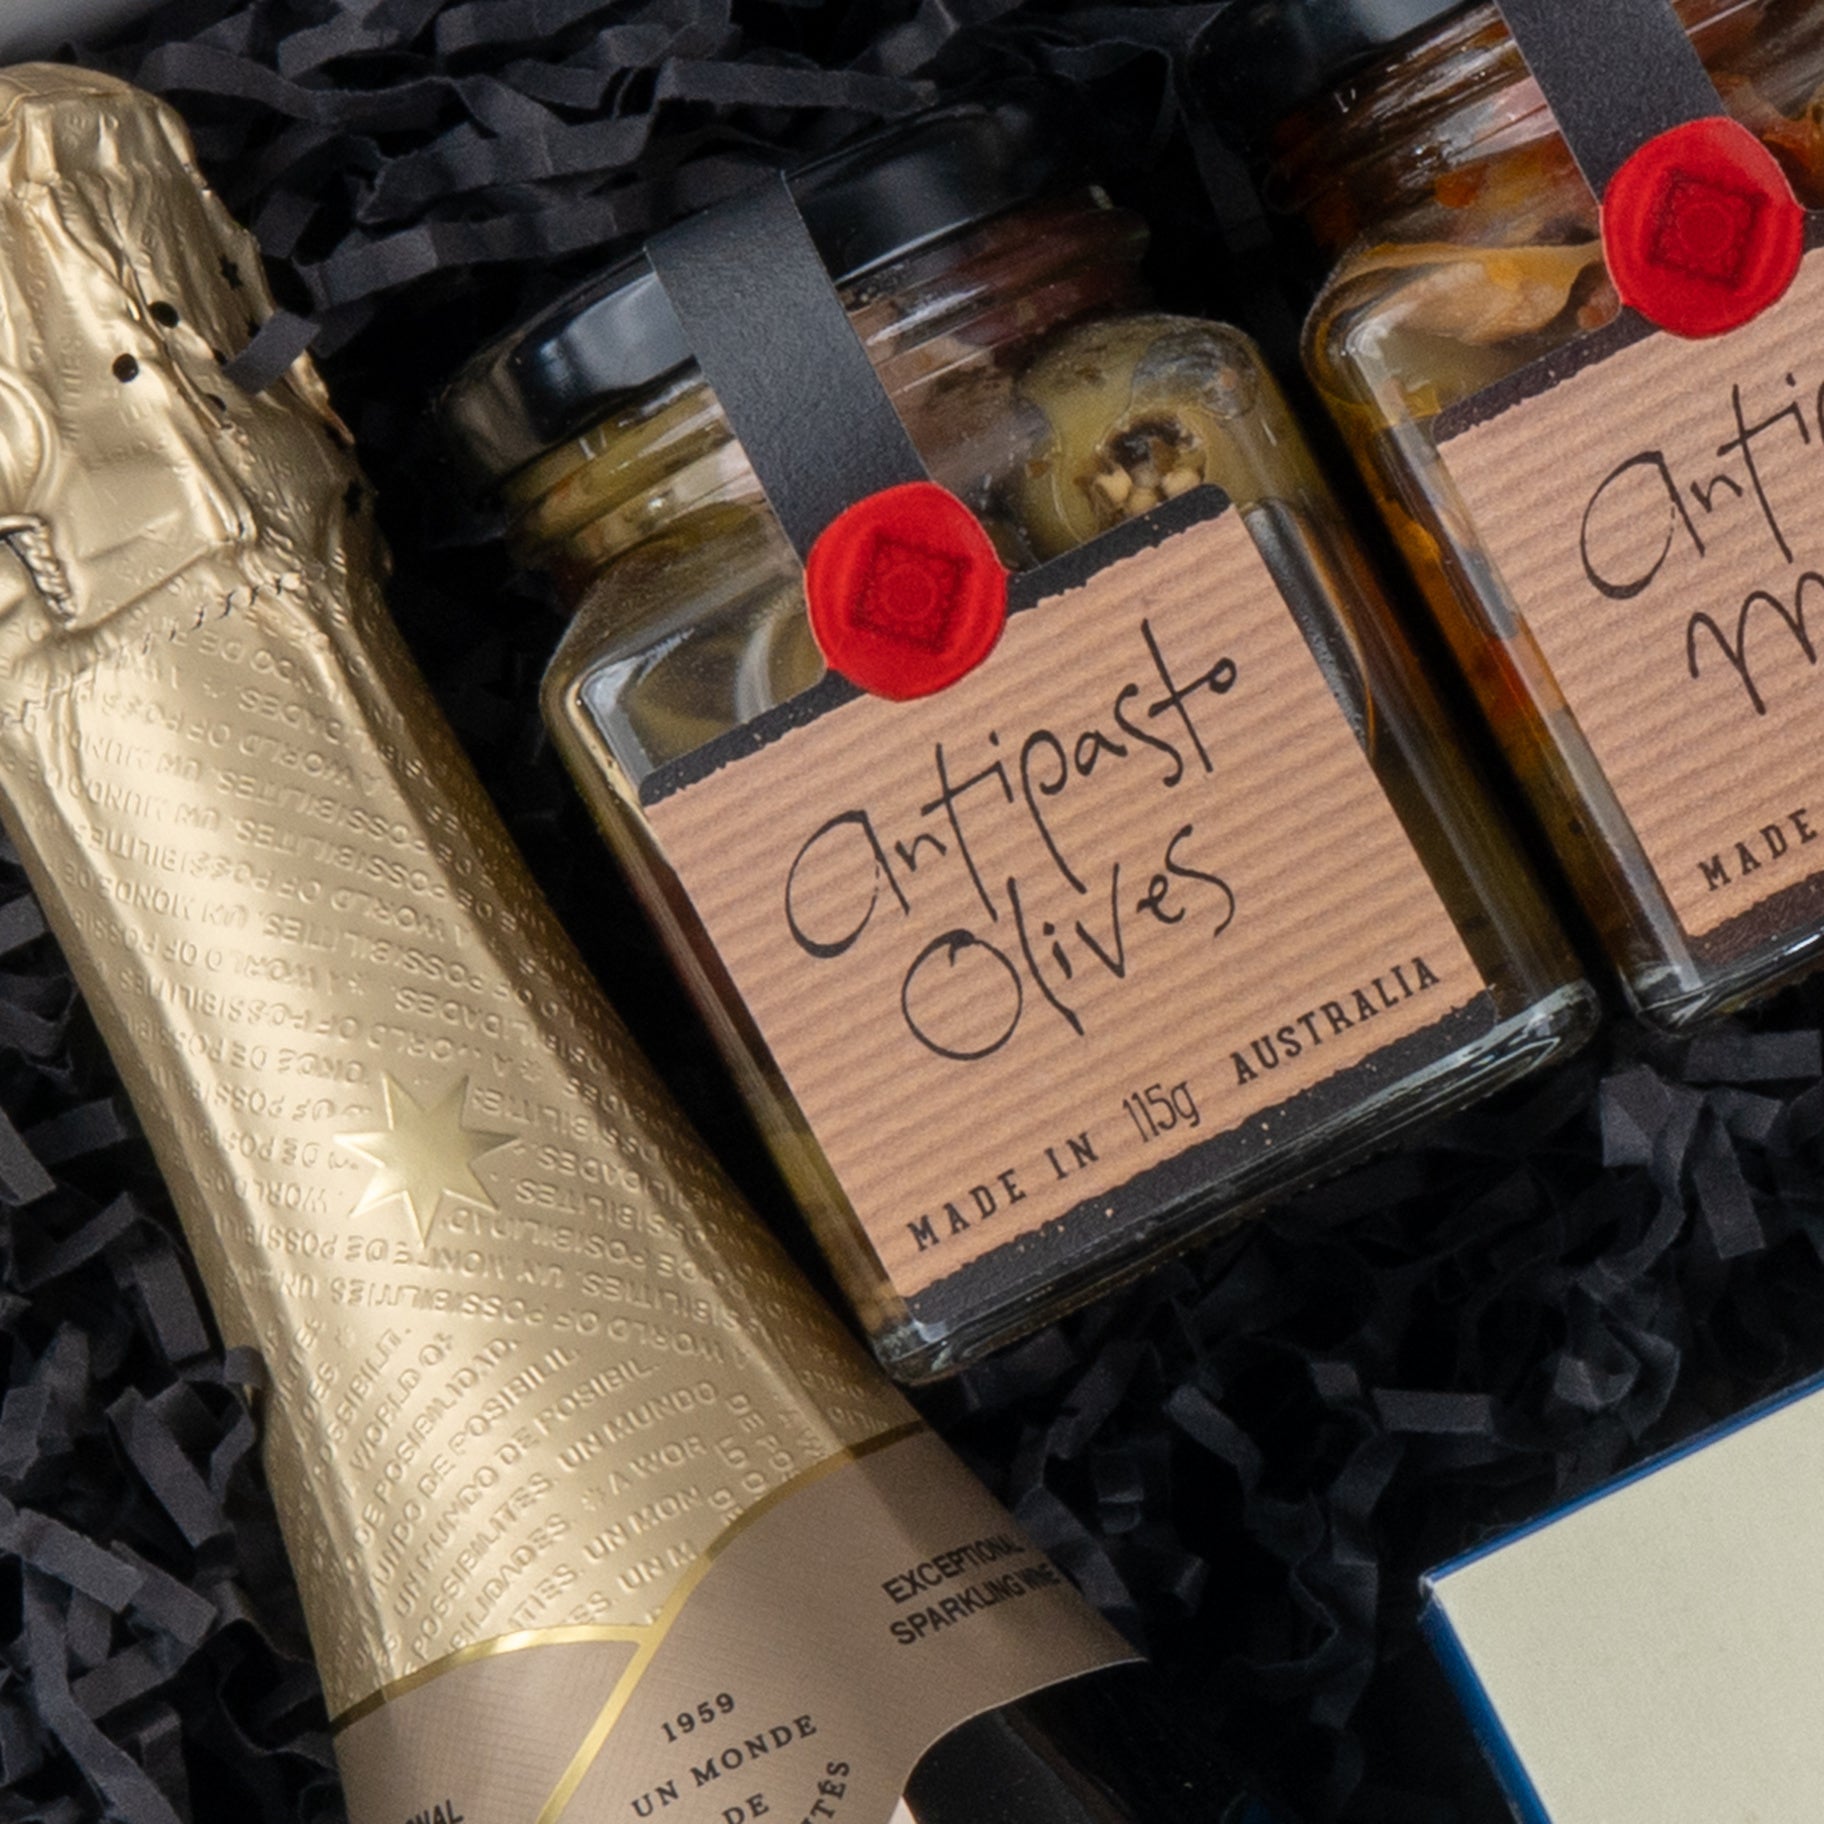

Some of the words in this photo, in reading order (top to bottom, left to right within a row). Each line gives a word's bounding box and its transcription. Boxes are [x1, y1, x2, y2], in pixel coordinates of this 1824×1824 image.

[1580, 373, 1824, 600] Anti
[1697, 808, 1819, 891] MADE
[276, 874, 320, 904] OF
[902, 824, 1235, 1061] Olives
[906, 1169, 1027, 1252] MADE
[1043, 1131, 1099, 1180] IN
[1122, 1081, 1200, 1143] 115g
[1229, 956, 1441, 1086] AUSTRALIA
[556, 1431, 601, 1472] UN
[601, 1381, 717, 1442] MUNDO
[603, 1467, 633, 1497] A
[580, 1522, 630, 1564] UN
[615, 1552, 668, 1594] UN
[889, 1572, 1027, 1645] SPARKLING
[660, 1692, 735, 1743] 1959
[631, 1779, 681, 1819] UN
[688, 1713, 818, 1788] MONDE
[721, 1792, 770, 1824] DE
